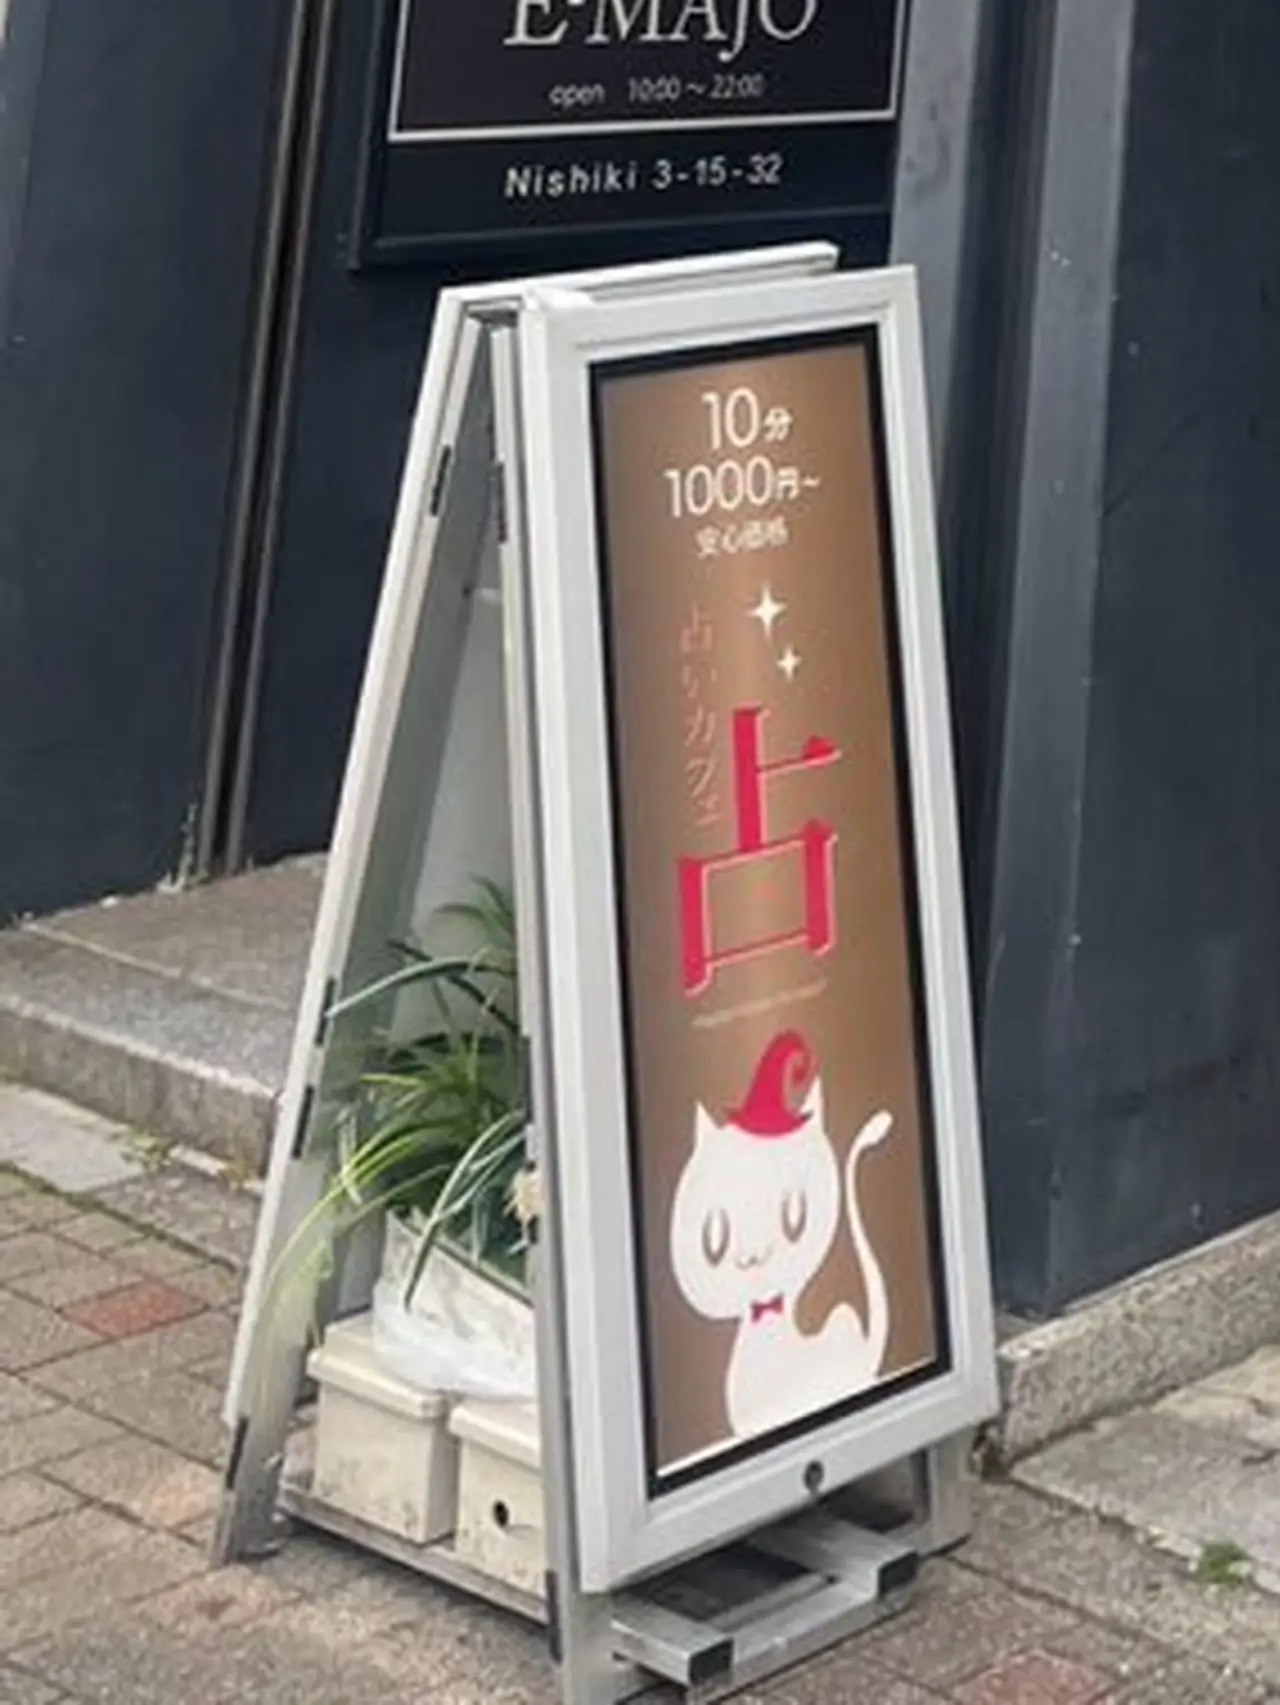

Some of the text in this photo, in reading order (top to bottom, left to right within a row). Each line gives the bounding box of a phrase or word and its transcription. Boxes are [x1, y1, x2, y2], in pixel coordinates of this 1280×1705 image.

[549, 83, 605, 108] open
[505, 152, 784, 198] Nishiki 3-15-32
[701, 387, 794, 450] 10分
[677, 704, 842, 998] 占
